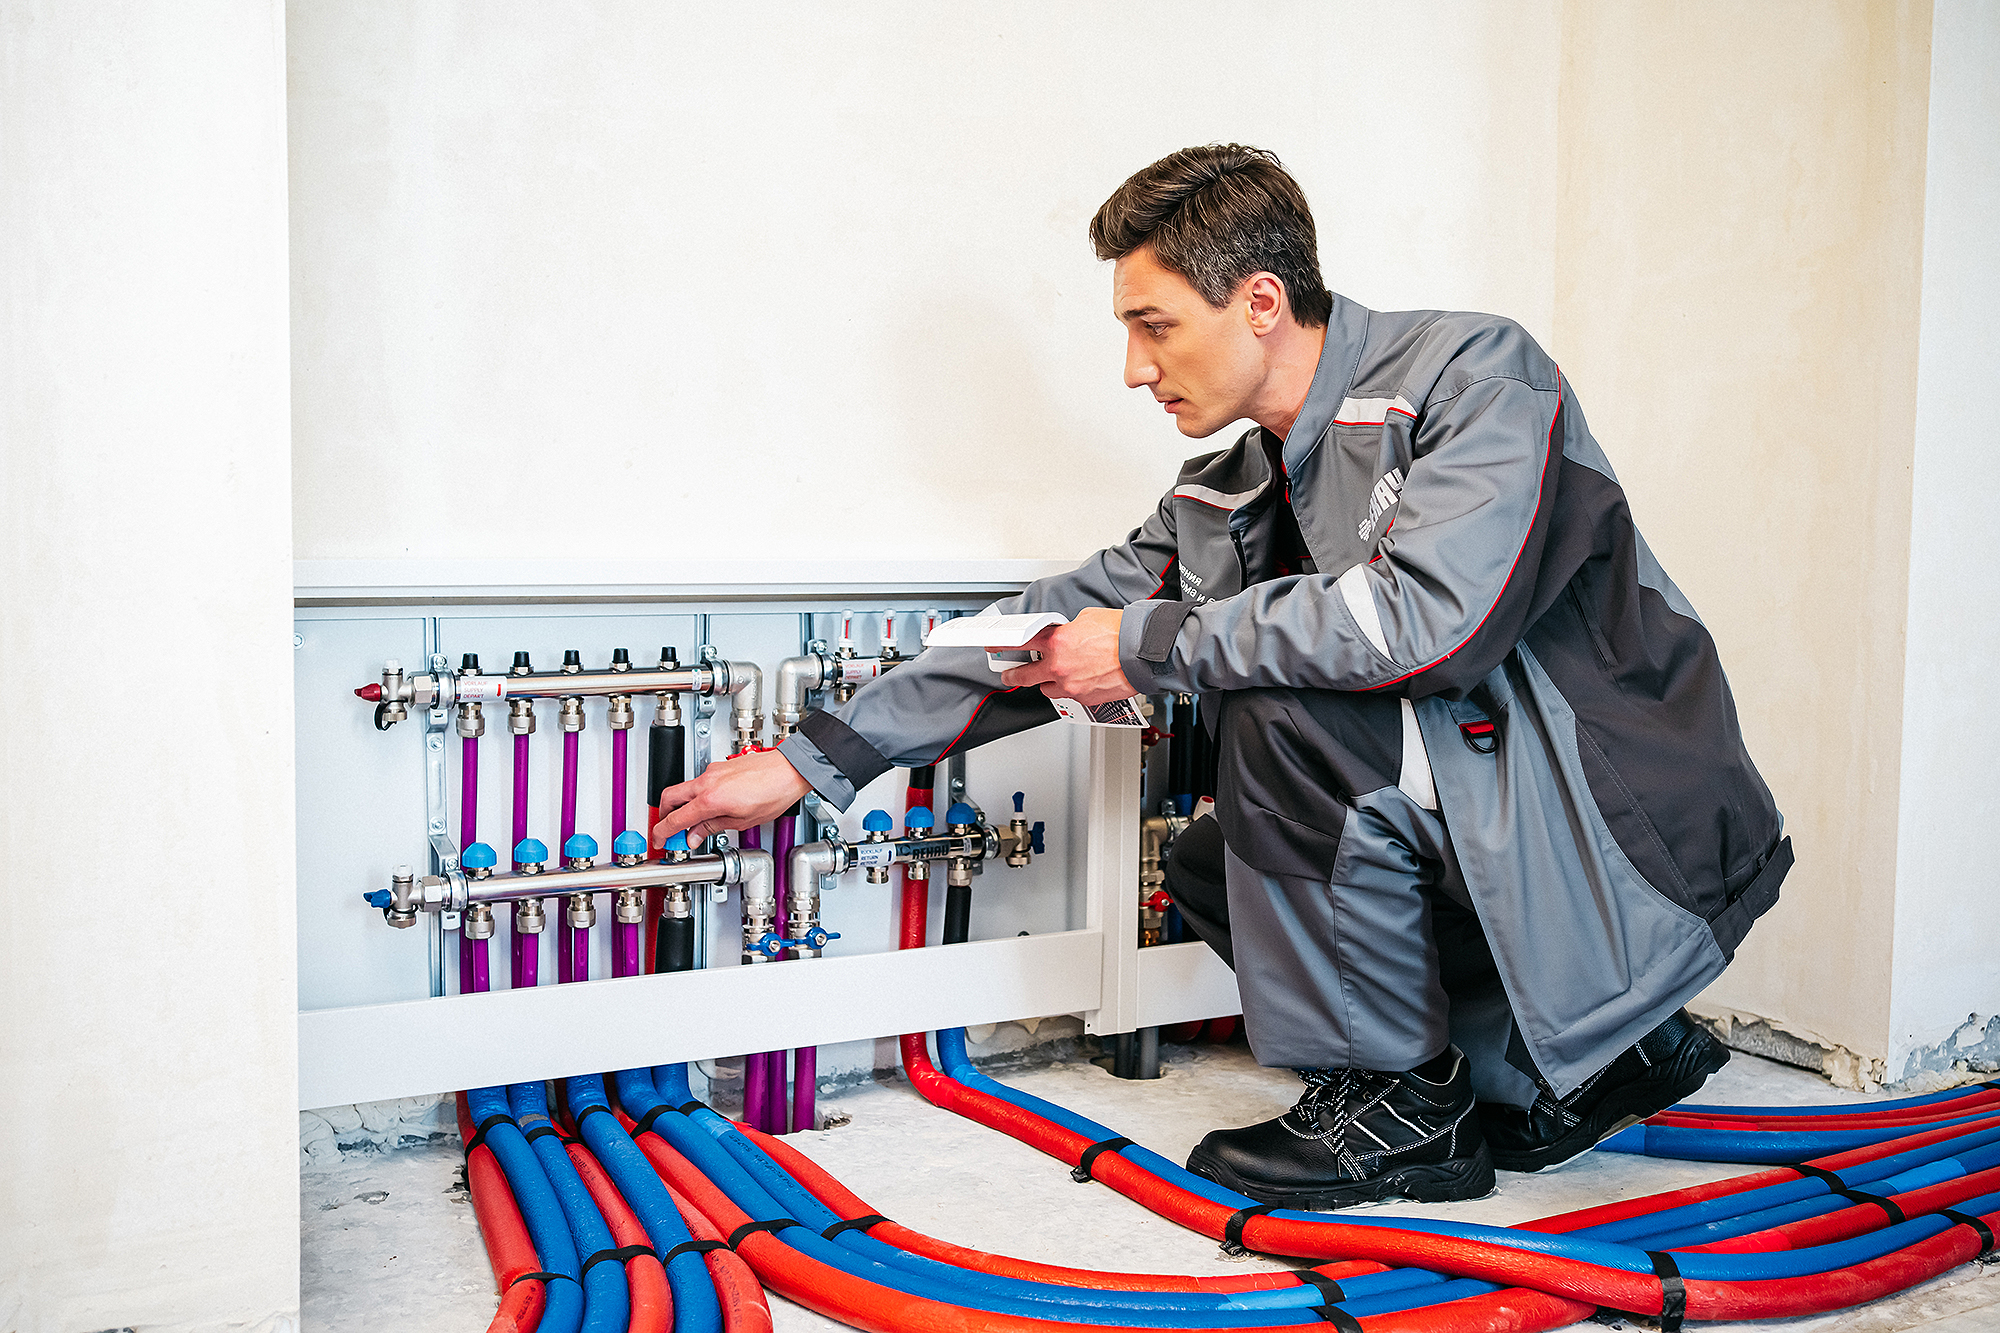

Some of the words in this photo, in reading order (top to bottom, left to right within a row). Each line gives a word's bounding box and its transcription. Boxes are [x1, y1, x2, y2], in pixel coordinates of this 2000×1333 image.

[1368, 467, 1404, 532] EHAU
[1180, 576, 1198, 598] ома
[912, 845, 949, 859] REHAU
